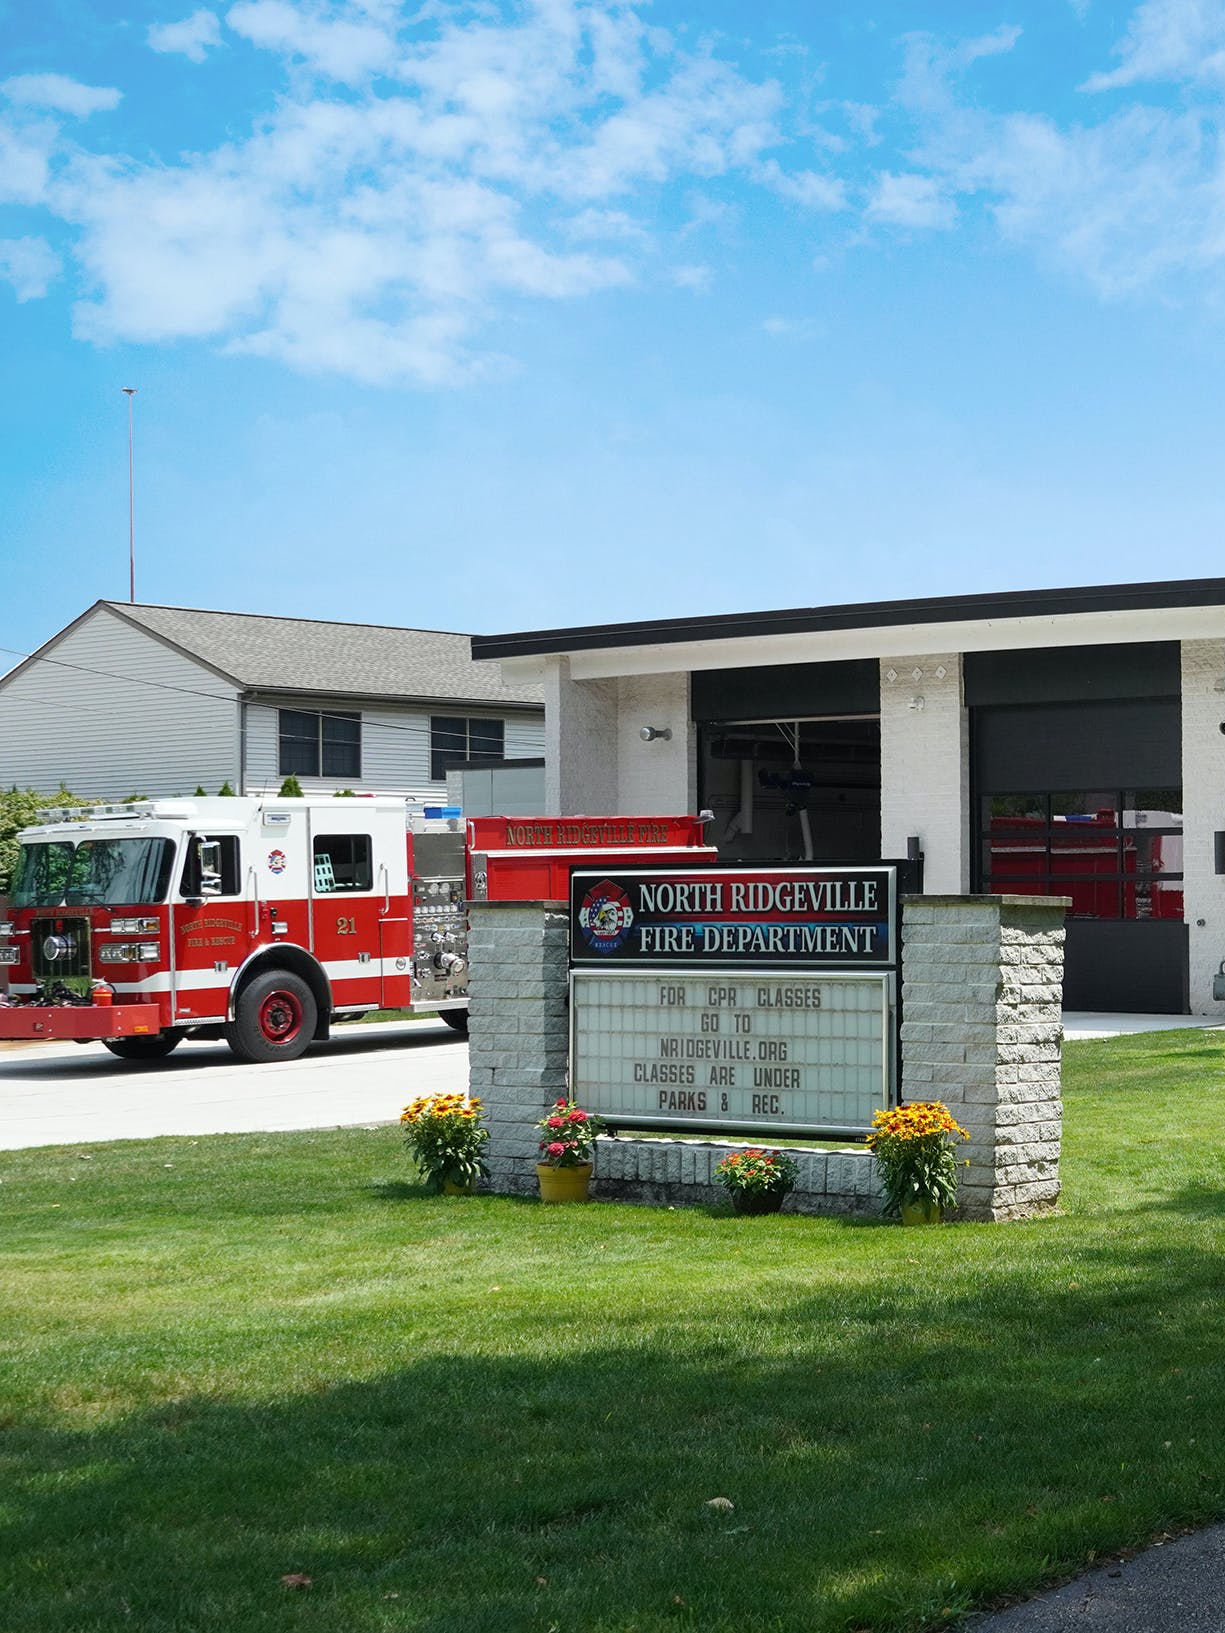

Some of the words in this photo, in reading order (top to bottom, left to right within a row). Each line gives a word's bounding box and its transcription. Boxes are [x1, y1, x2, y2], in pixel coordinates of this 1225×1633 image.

[506, 825, 553, 846] NORTH
[557, 824, 635, 845] RIDGEVILLE
[637, 824, 669, 843] FIRE
[639, 883, 723, 913] NORTH
[730, 881, 878, 912] RIDGEVILLE
[336, 917, 357, 935] 21
[639, 926, 694, 953] FIRE
[702, 926, 877, 953] DEPARTMENT
[660, 986, 686, 1006] FOR
[708, 987, 736, 1007] CPR
[757, 988, 822, 1008] CLASSES
[701, 1013, 719, 1033] GO
[734, 1014, 751, 1034] TO
[660, 1038, 788, 1062] NRIDGEVILLE.ORG
[634, 1063, 695, 1085] CLASSES
[709, 1066, 735, 1086] ARE
[753, 1067, 801, 1089] UNDER
[659, 1090, 707, 1112] PARKS
[721, 1092, 729, 1112] &
[752, 1094, 785, 1116] REC.
